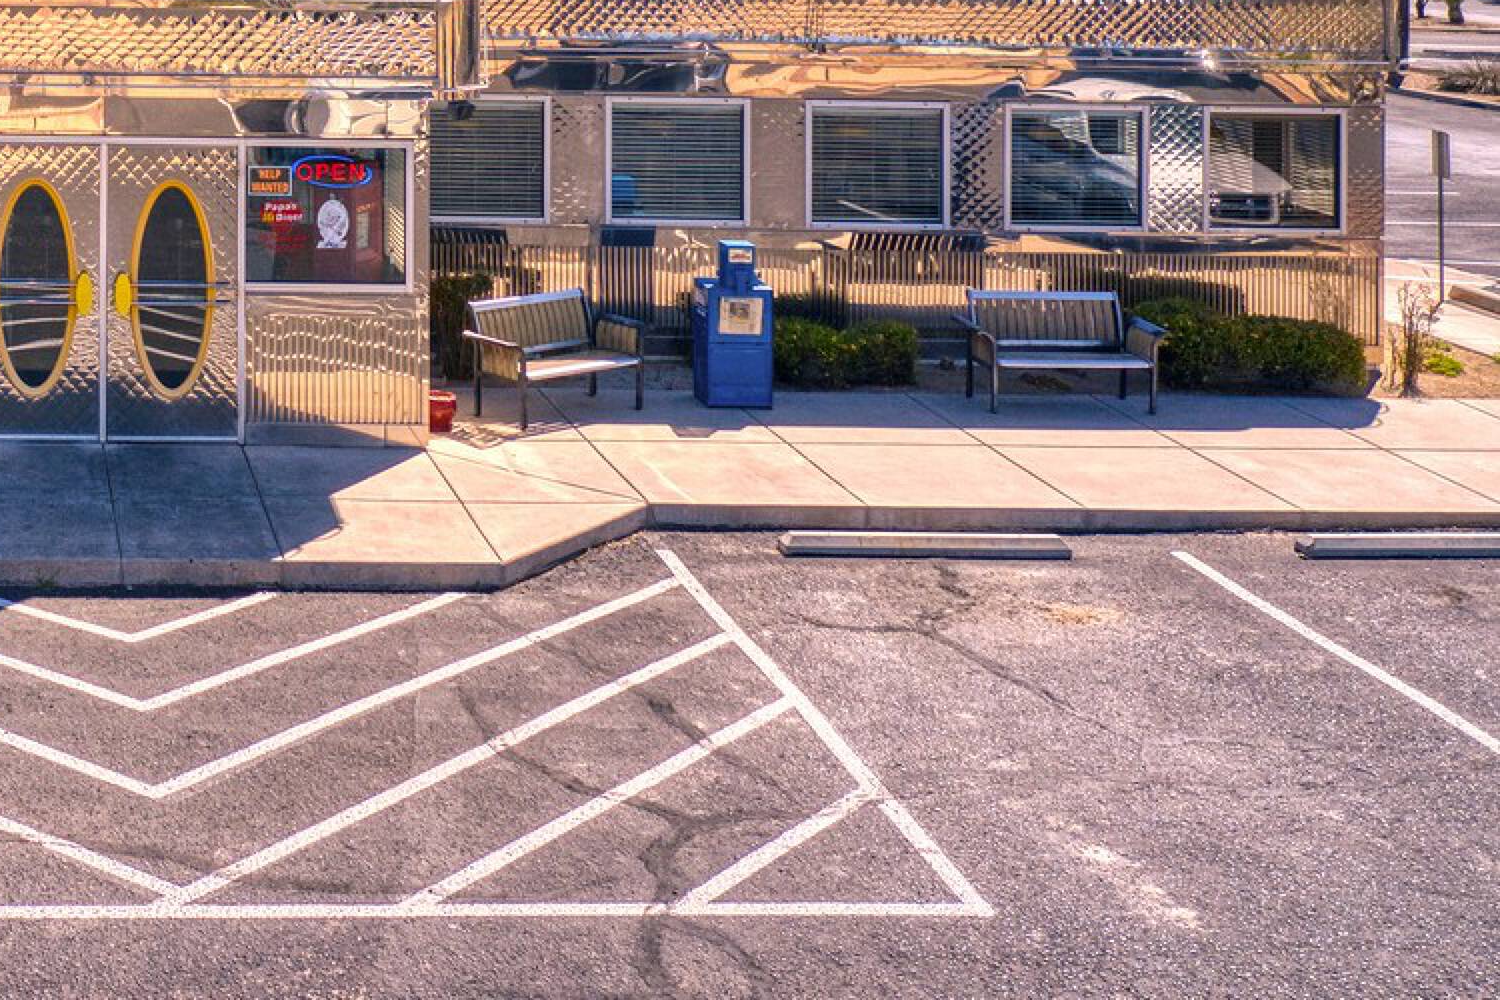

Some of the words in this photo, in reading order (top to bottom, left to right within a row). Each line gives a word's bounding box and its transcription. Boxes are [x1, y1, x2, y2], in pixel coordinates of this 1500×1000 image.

[259, 168, 281, 179] HELP
[296, 163, 366, 182] OPEN
[251, 181, 289, 193] WANTED
